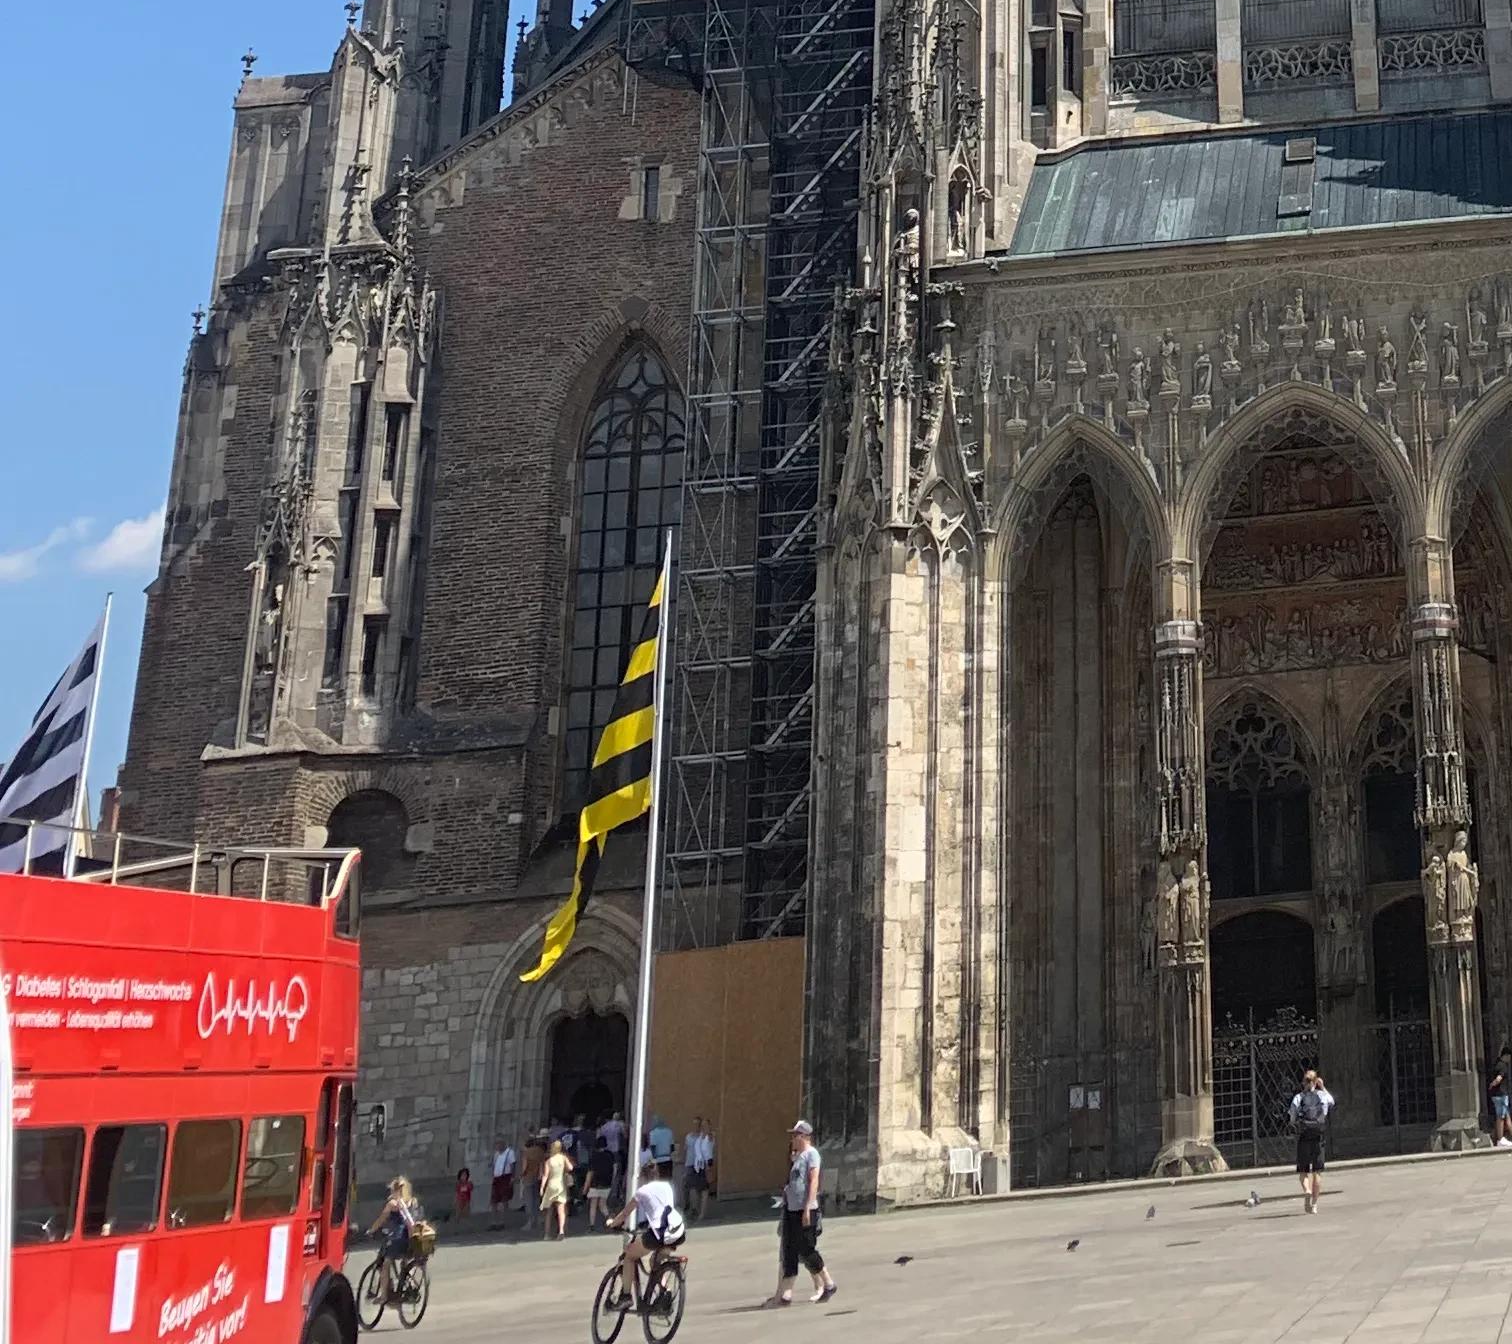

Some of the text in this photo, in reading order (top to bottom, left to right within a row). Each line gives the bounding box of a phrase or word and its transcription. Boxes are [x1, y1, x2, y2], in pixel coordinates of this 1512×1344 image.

[16, 975, 61, 998] Diabetes
[67, 975, 125, 1004] Schlaganfall
[158, 1284, 211, 1338] Beugen
[211, 1261, 235, 1305] Sie
